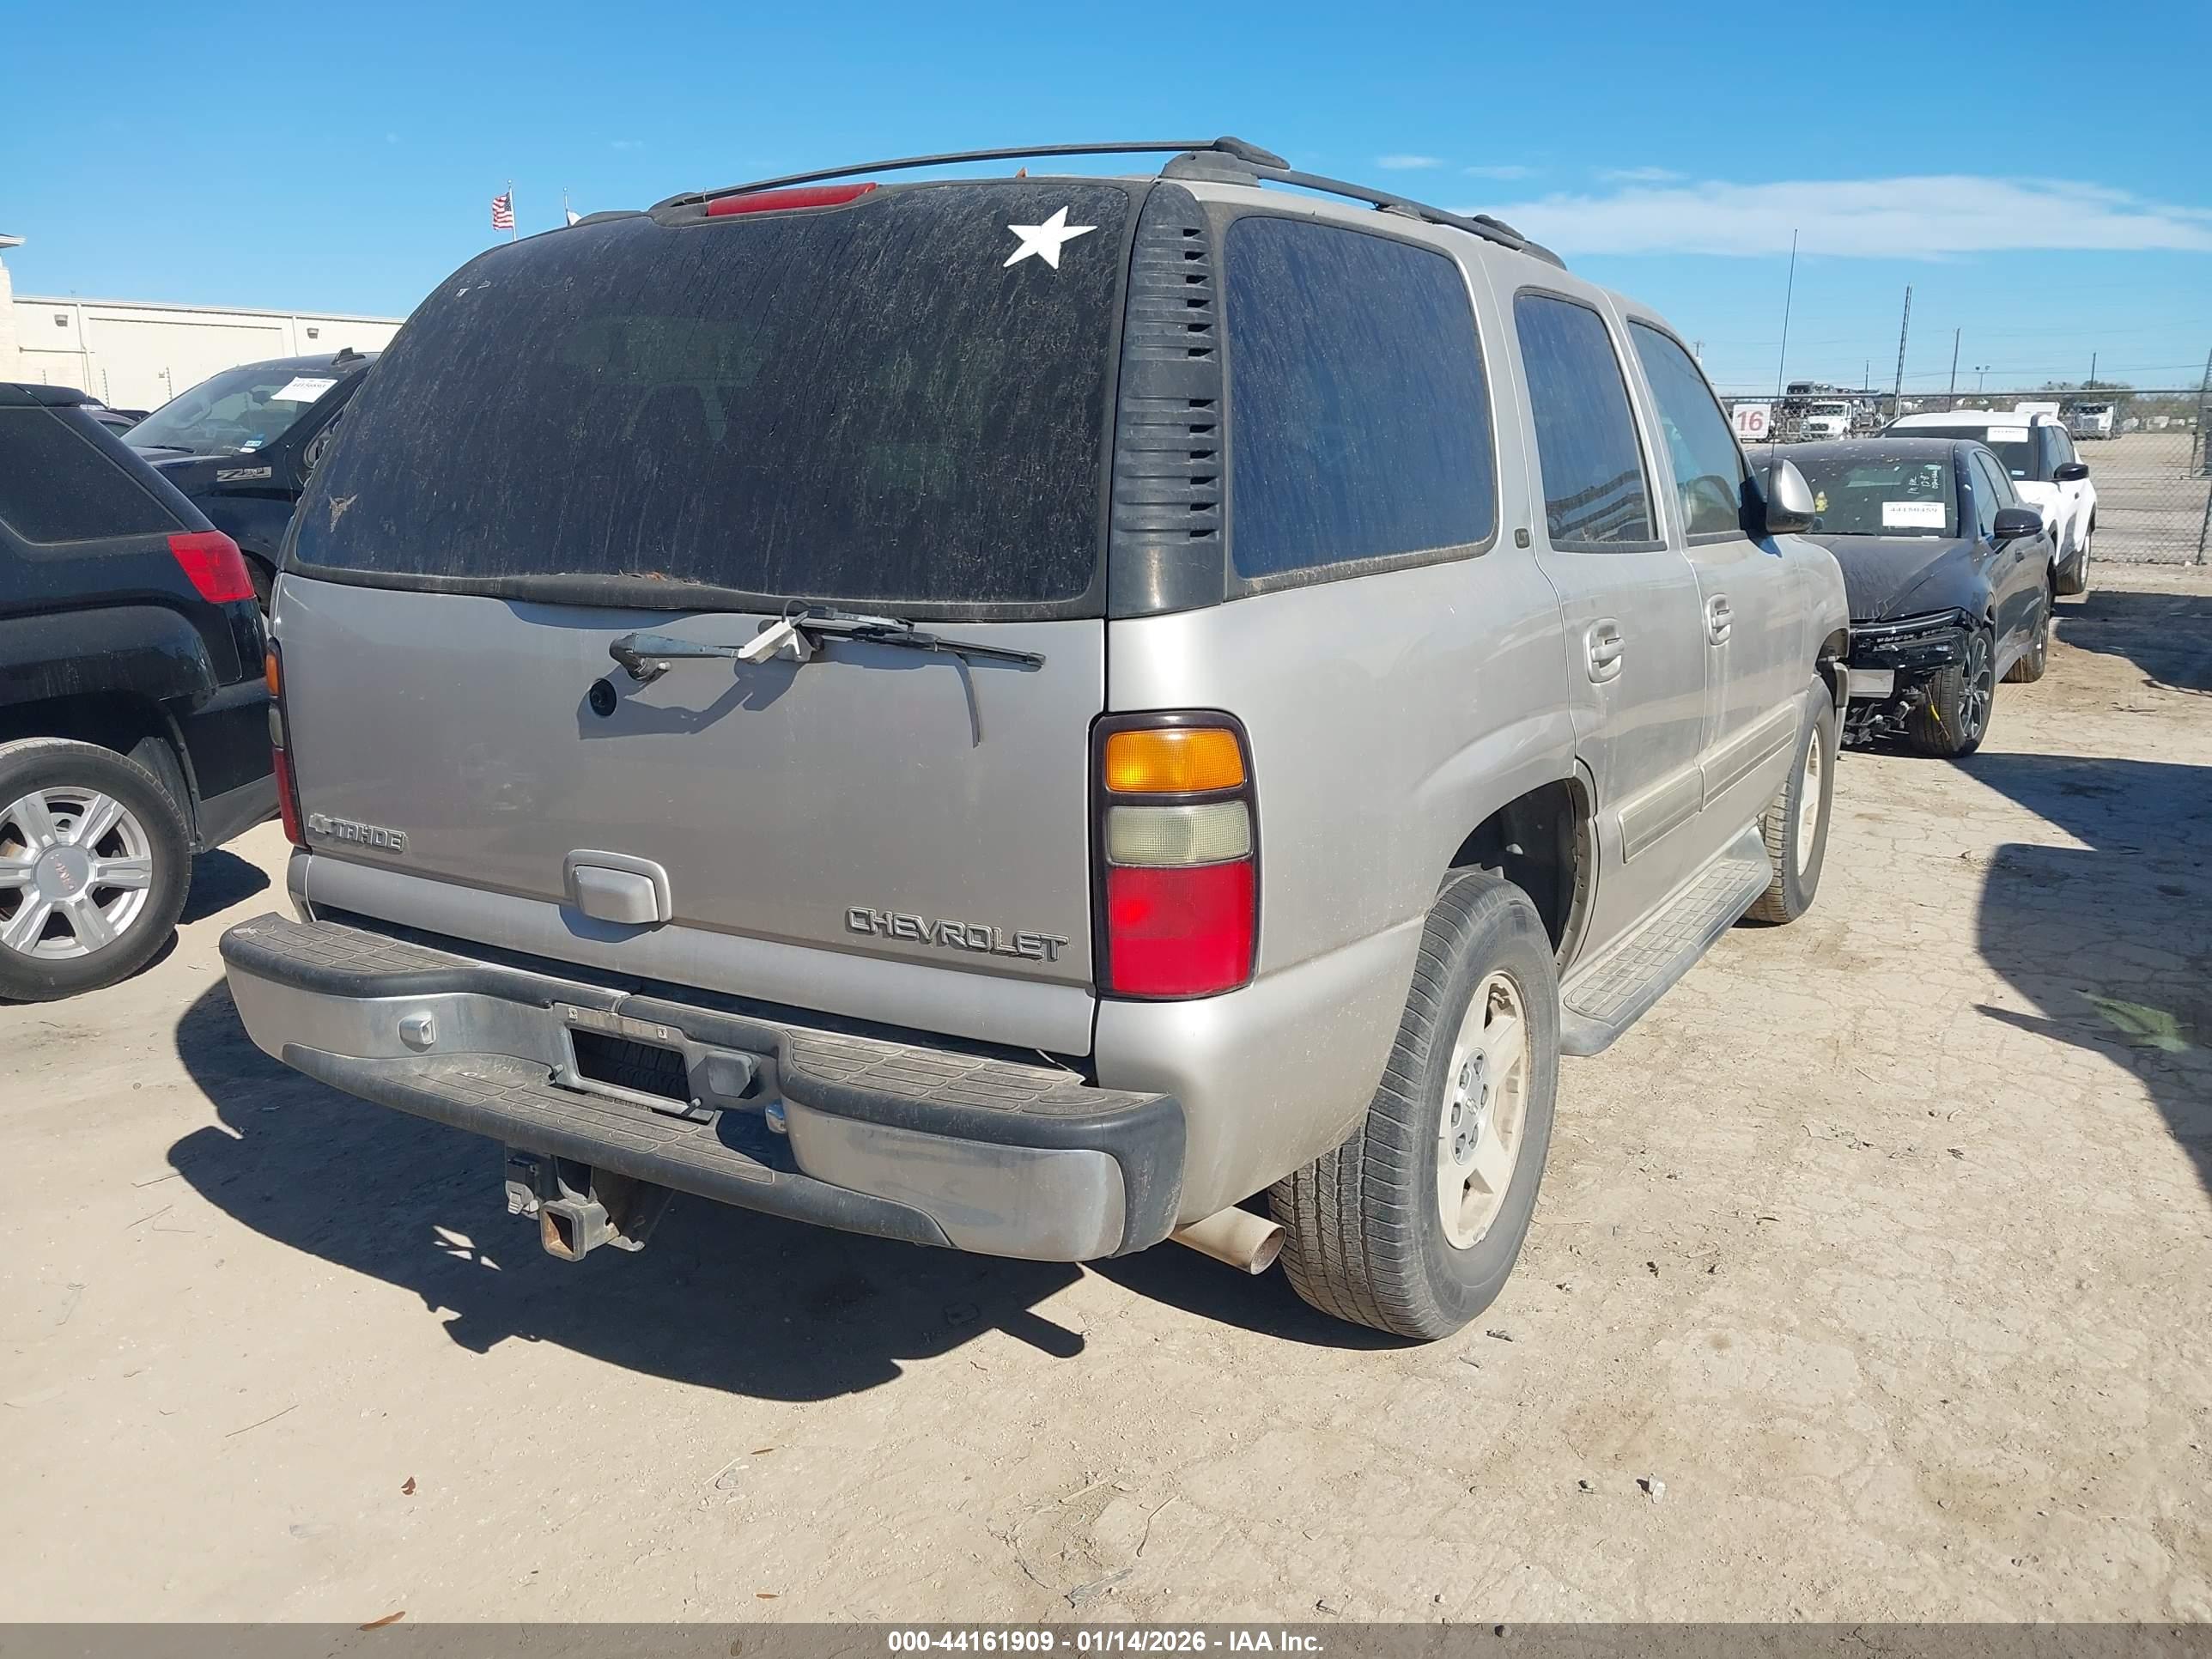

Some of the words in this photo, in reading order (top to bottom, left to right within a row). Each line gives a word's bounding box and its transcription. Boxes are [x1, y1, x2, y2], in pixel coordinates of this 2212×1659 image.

[1737, 410, 1764, 431] 16
[330, 818, 408, 853] TAHOE
[844, 905, 1070, 962] CHEVROLET
